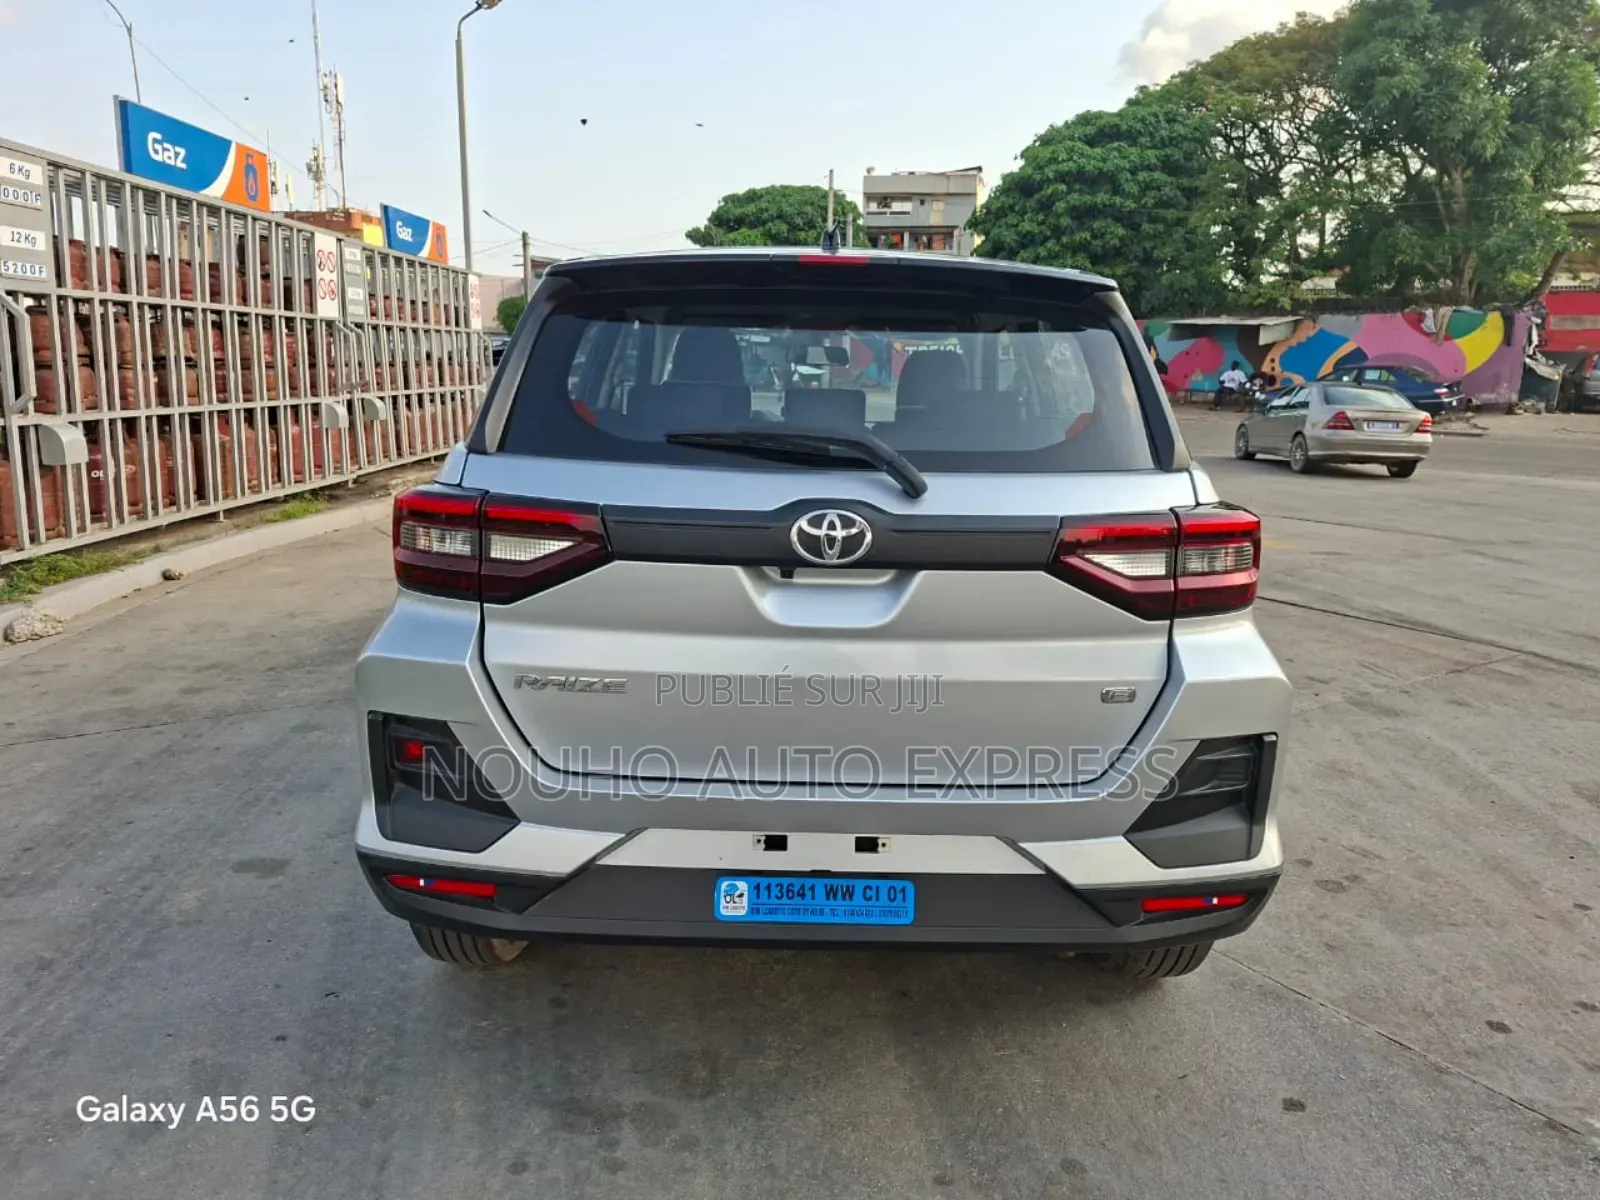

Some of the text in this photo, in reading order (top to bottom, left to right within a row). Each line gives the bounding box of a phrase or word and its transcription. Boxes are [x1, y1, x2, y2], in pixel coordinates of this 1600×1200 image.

[147, 131, 187, 170] Gaz
[9, 163, 31, 179] 6 Kg
[10, 230, 37, 247] 12 Kg
[396, 221, 413, 242] Gaz
[512, 673, 629, 695] RAIZE
[753, 882, 907, 904] 113641 WW CI 01
